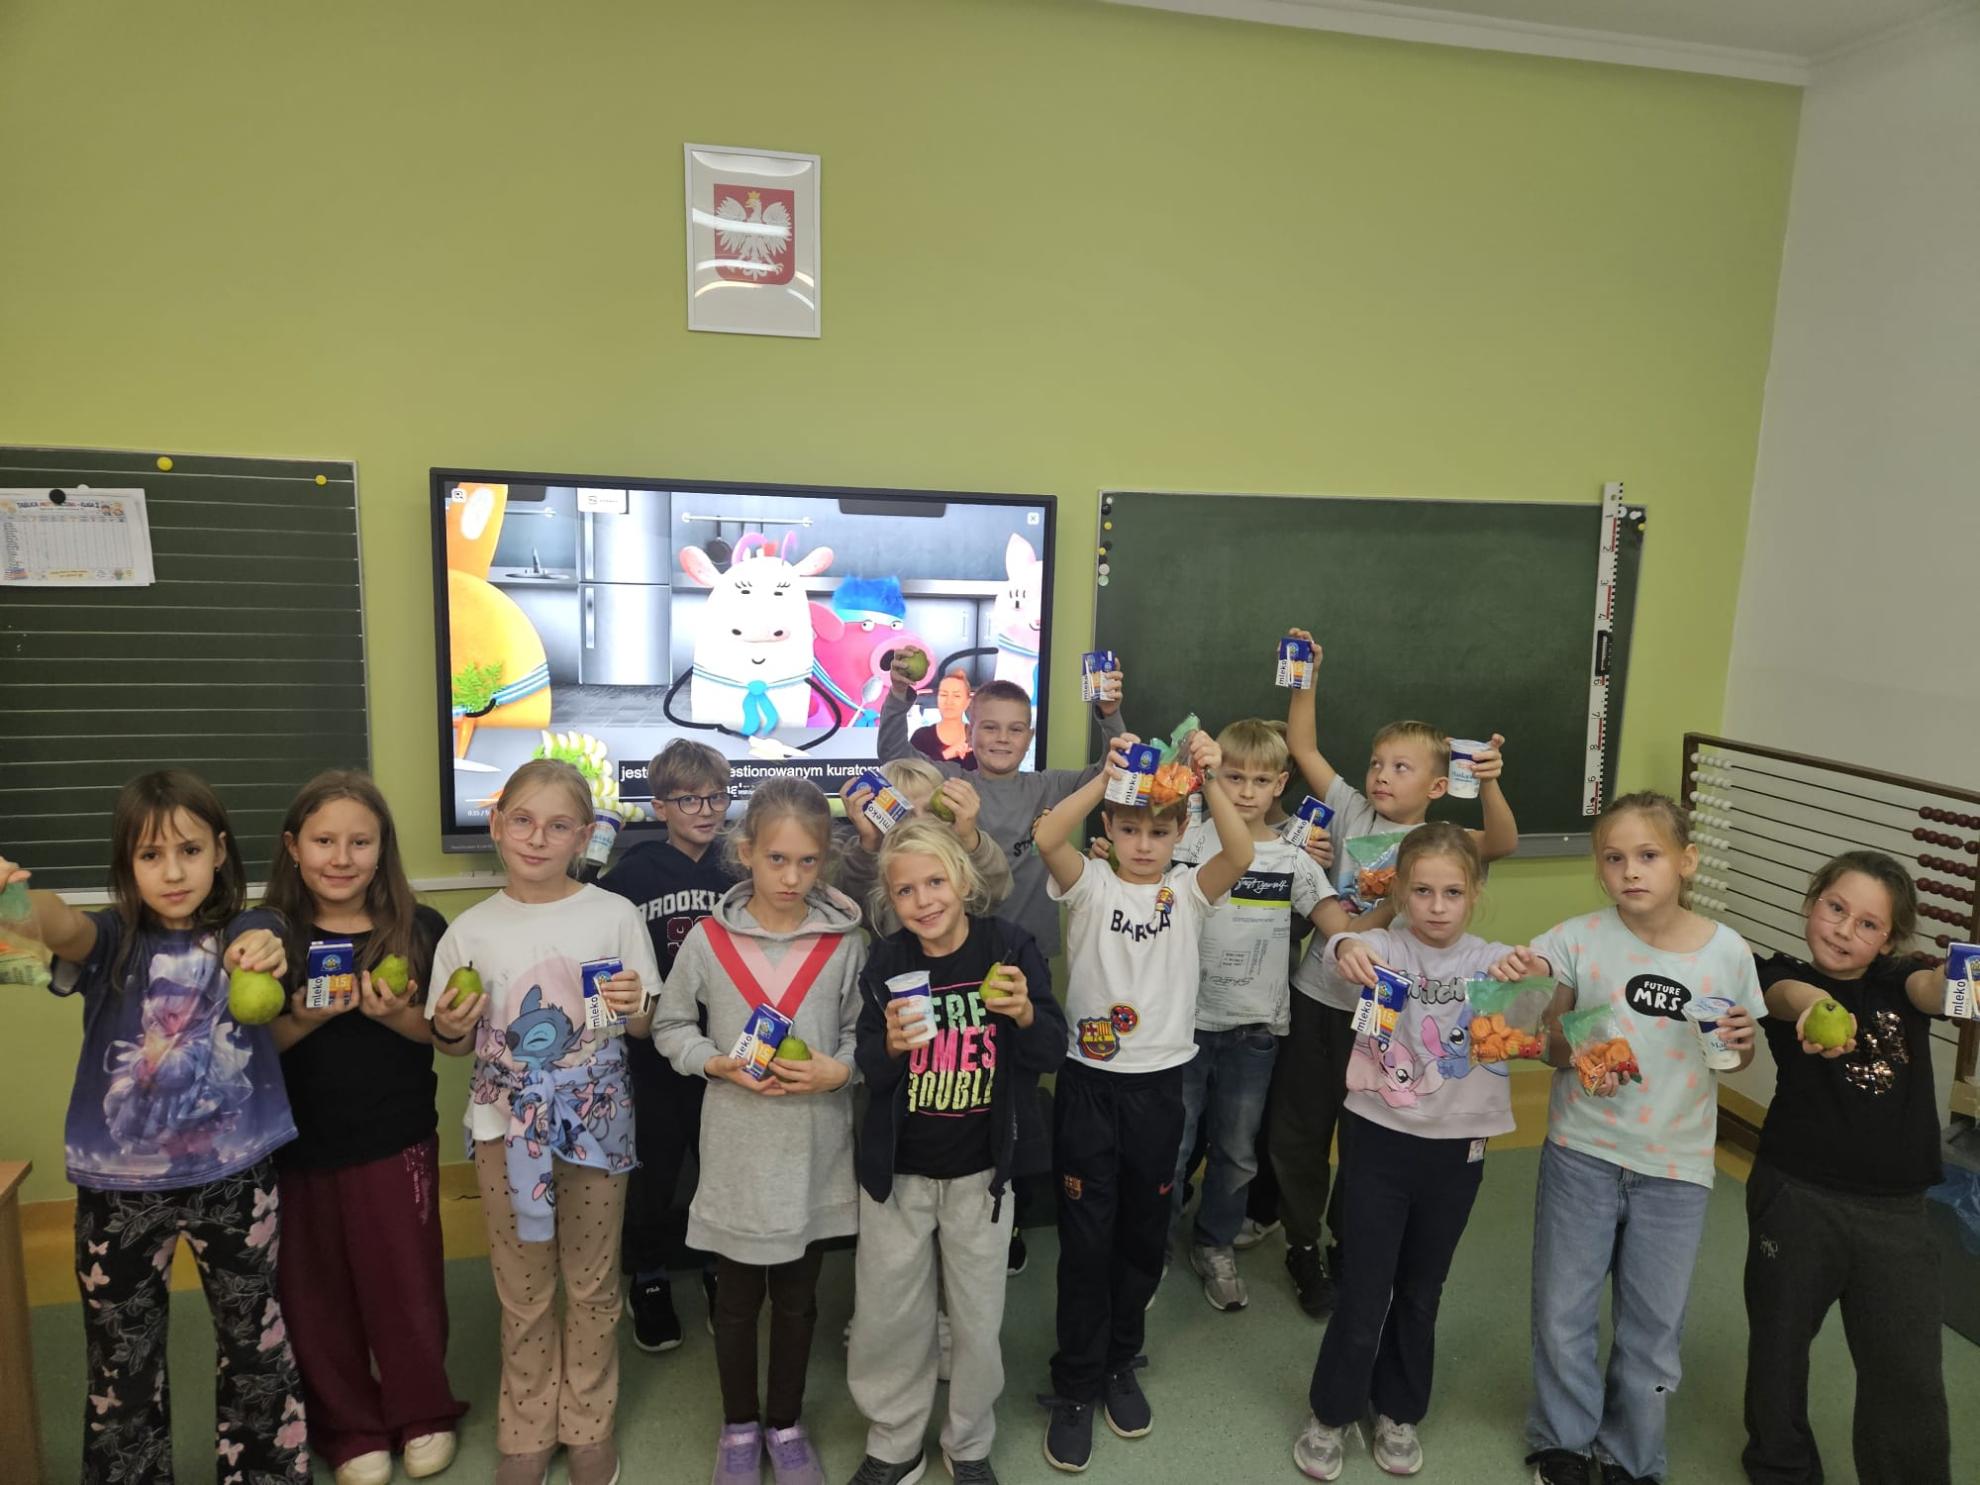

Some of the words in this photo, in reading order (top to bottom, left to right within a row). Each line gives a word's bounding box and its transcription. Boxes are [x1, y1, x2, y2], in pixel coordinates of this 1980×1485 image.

[1279, 660, 1287, 685] mleko
[1125, 774, 1138, 804] mleko
[1587, 775, 1596, 783] 9
[867, 805, 891, 830] mleko
[1585, 803, 1595, 815] 10
[1291, 821, 1308, 843] mleko
[313, 978, 323, 1007] mleko
[1643, 980, 1682, 997] FUTURE
[1952, 981, 1966, 1015] mleko
[590, 996, 600, 1028] mleko
[1357, 1001, 1373, 1032] mleko
